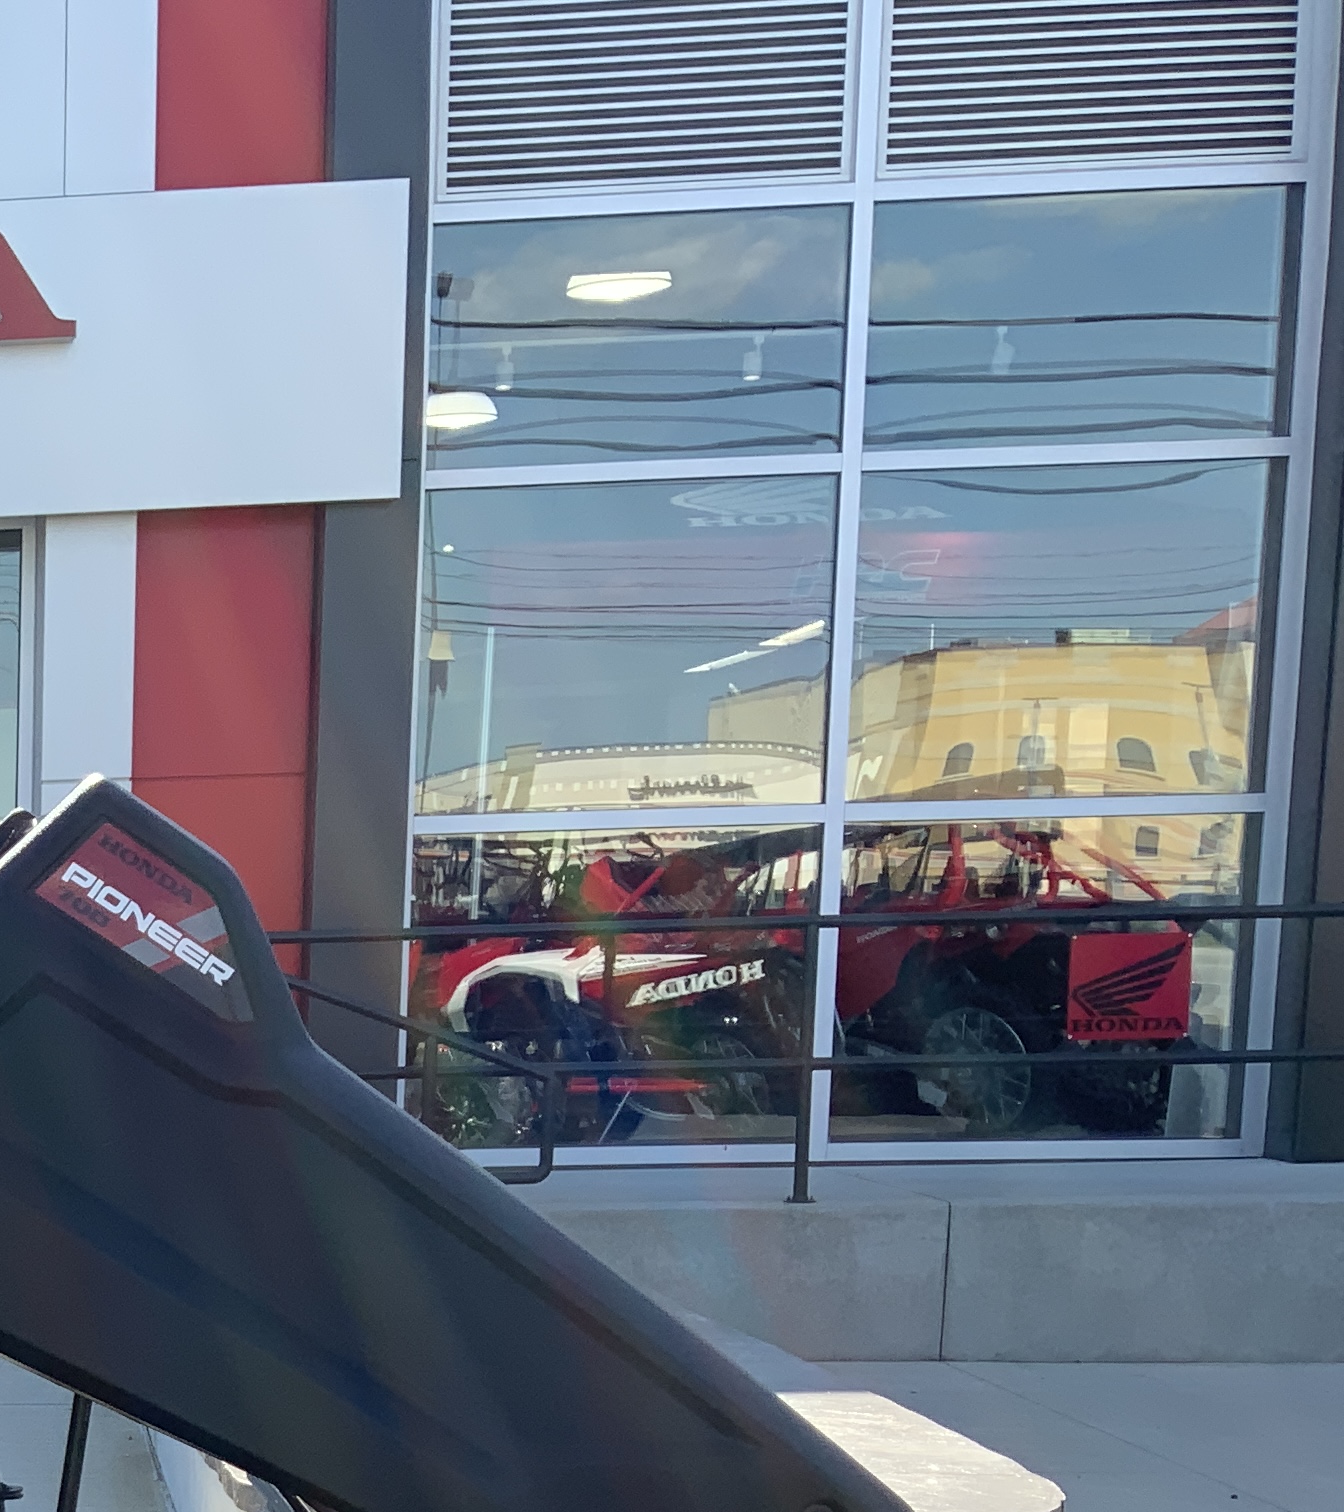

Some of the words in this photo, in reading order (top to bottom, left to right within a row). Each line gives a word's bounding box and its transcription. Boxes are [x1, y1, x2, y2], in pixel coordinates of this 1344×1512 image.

[97, 834, 193, 905] HONDA
[62, 861, 236, 987] PIONEER
[1073, 1017, 1184, 1032] HONDA
